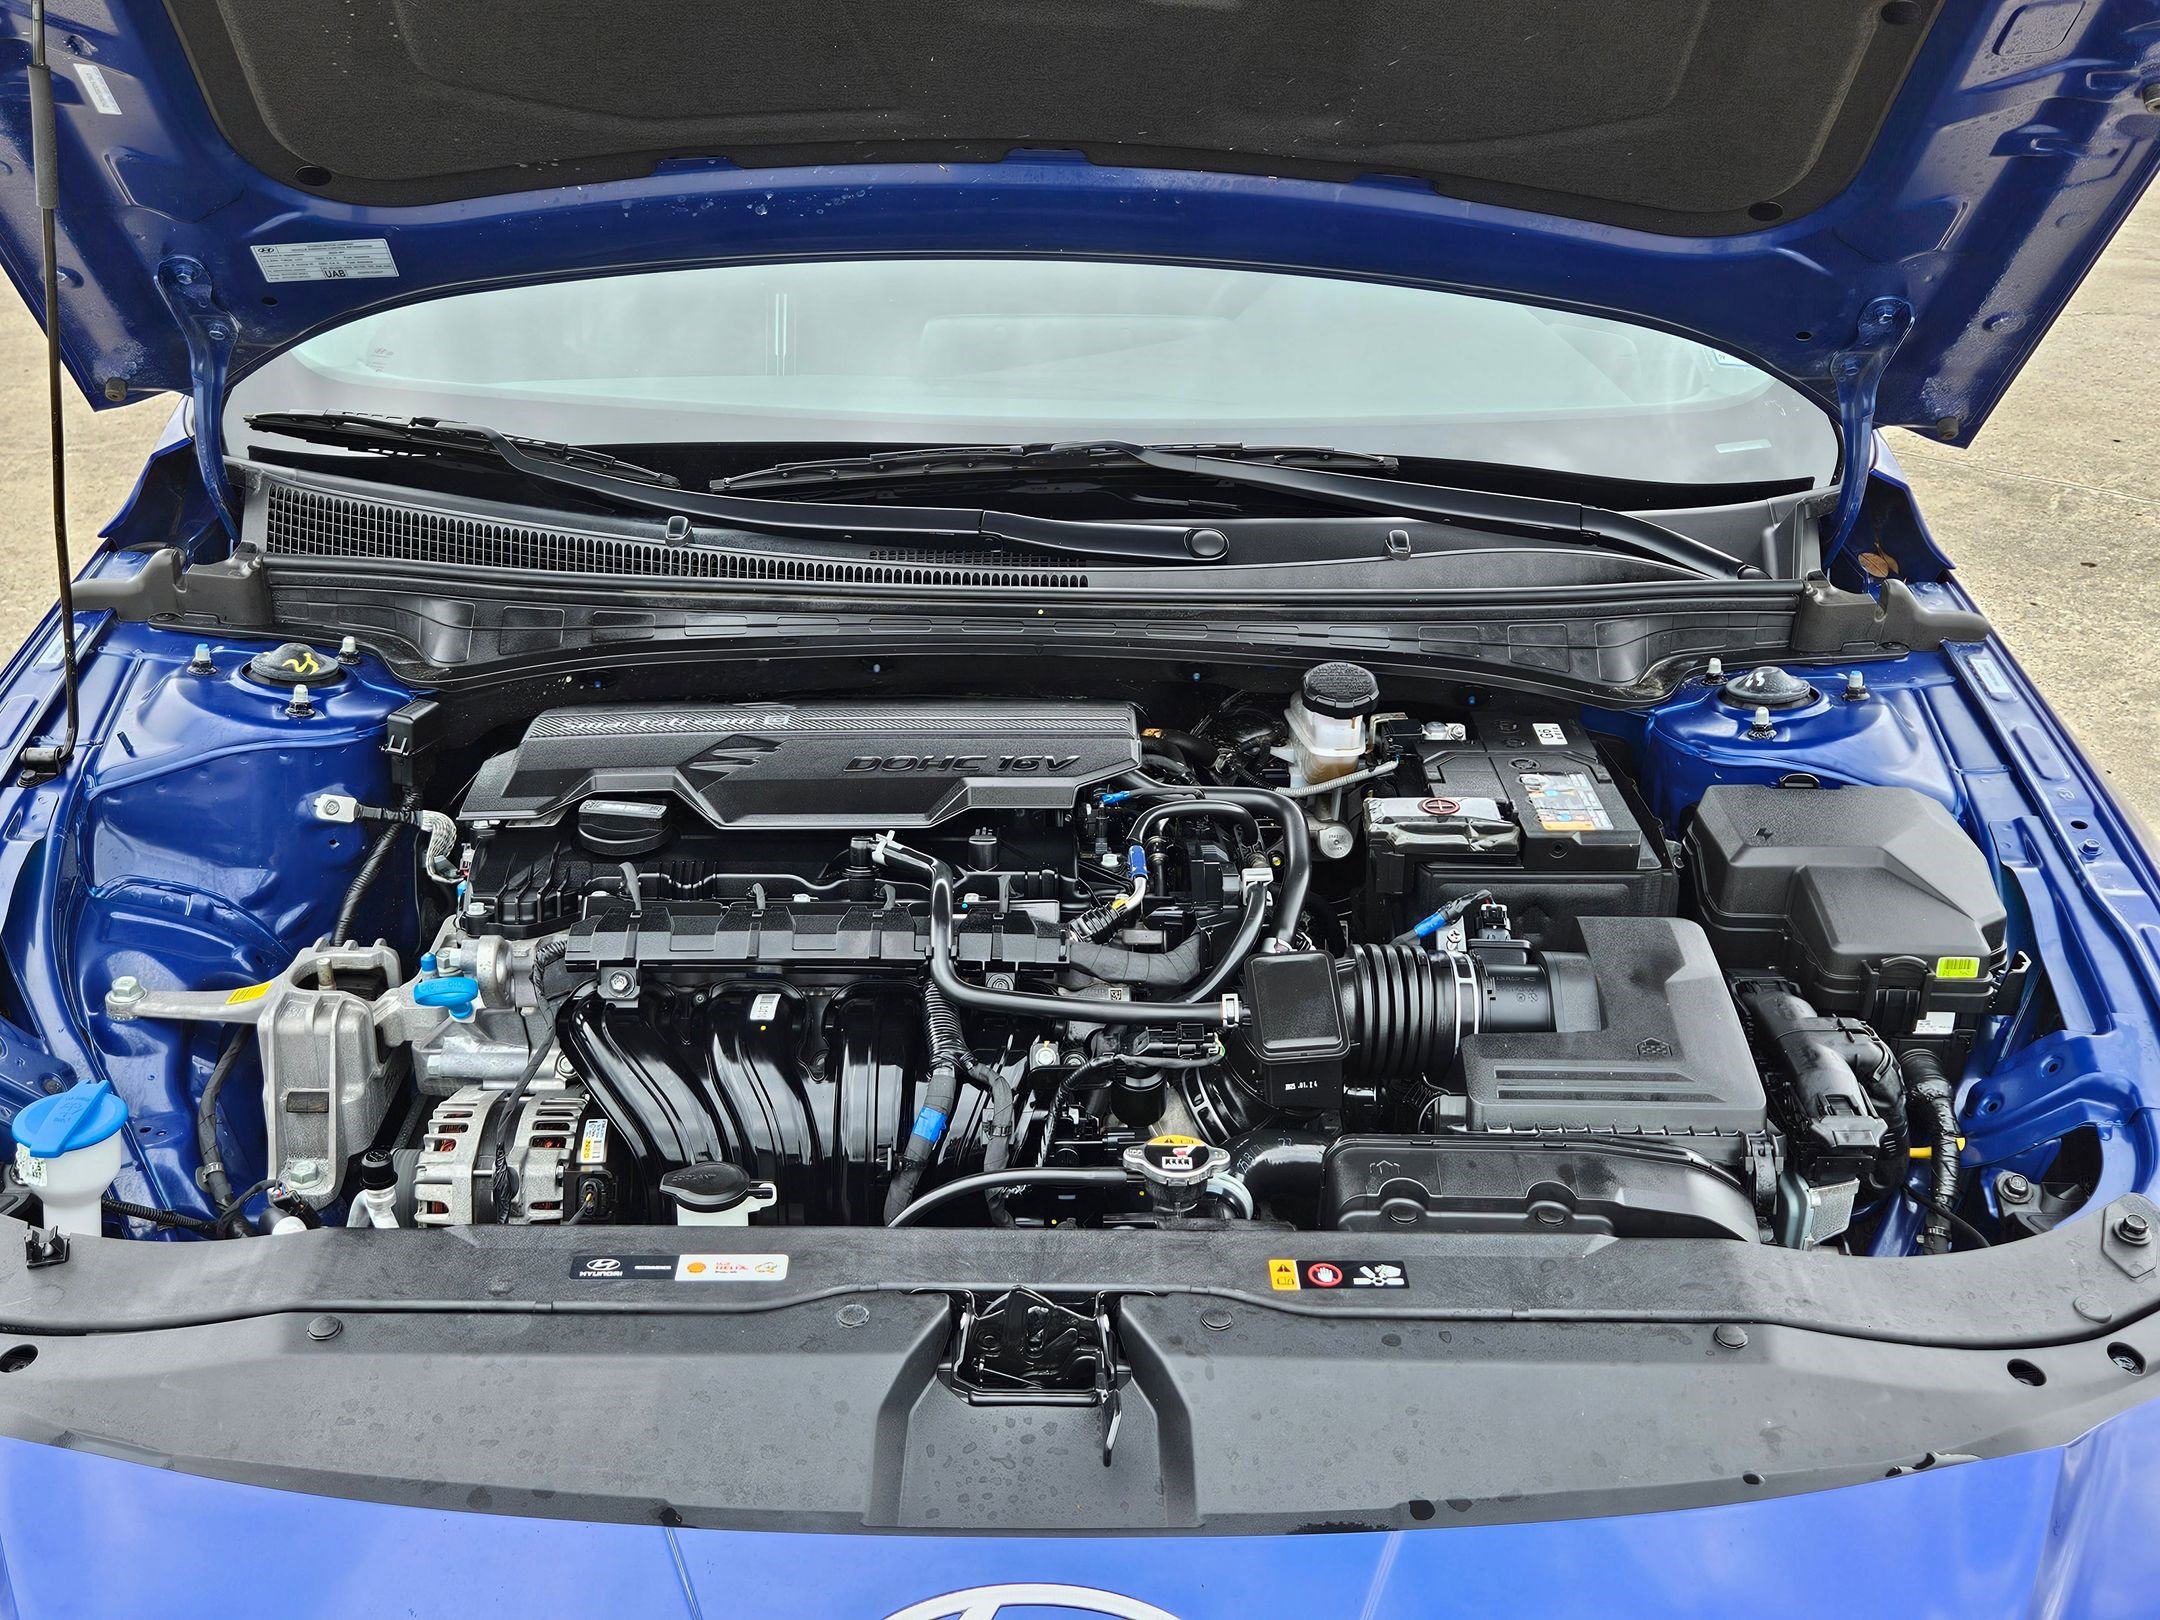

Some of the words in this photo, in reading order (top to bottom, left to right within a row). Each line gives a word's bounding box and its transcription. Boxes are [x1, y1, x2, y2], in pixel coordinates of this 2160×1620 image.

[325, 270, 346, 278] UAB
[843, 755, 987, 772] DOHC
[997, 755, 1080, 772] 16V
